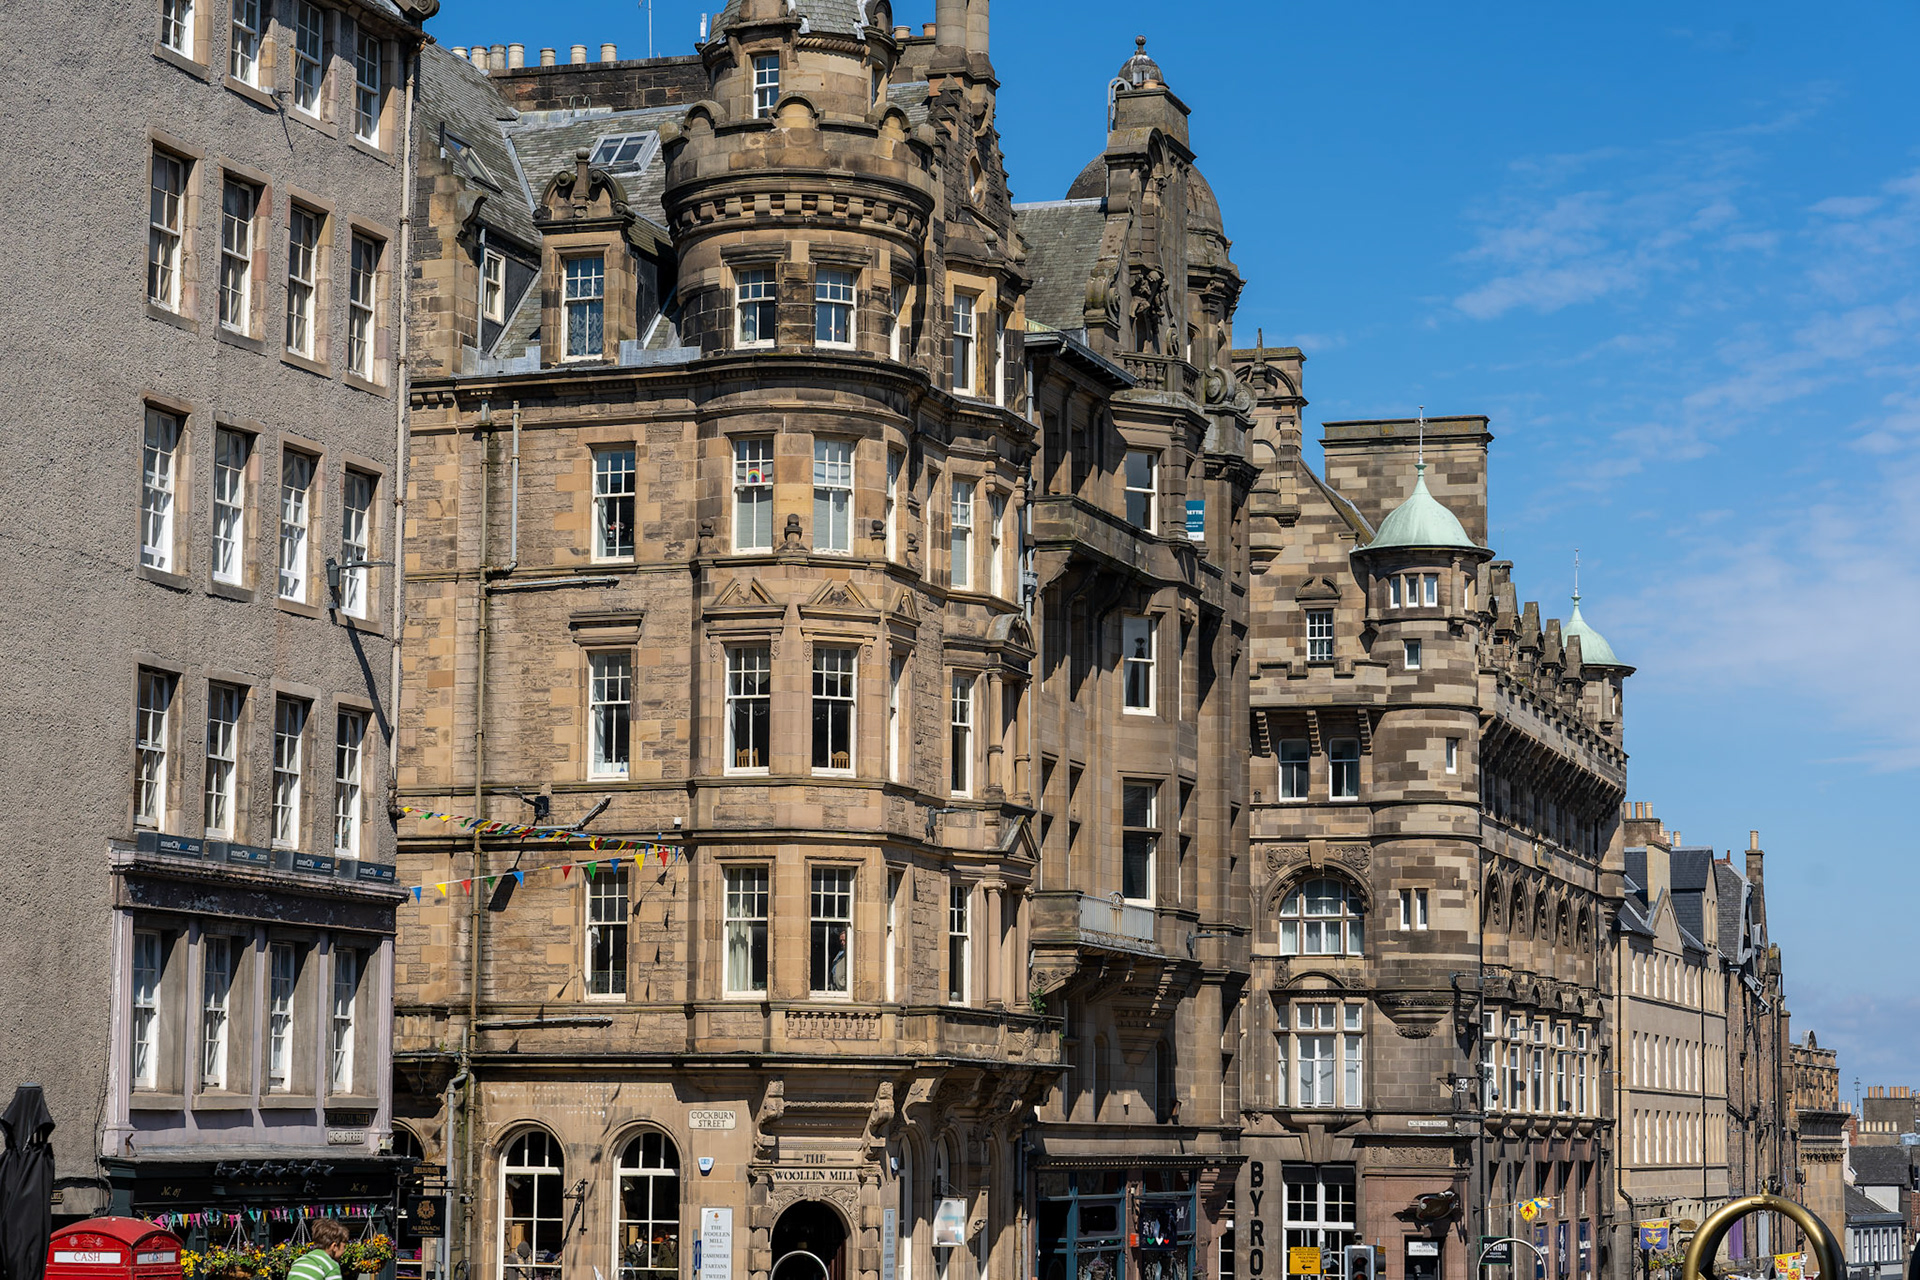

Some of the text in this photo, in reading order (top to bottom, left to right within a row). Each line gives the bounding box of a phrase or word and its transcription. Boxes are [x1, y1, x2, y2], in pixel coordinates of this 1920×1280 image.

[691, 1112, 734, 1120] COCKBURN
[804, 1154, 826, 1164] THE
[774, 1170, 855, 1180] WOOLLEN MILL
[1246, 1161, 1259, 1280] BYRO
[1484, 1242, 1508, 1252] BRON
[74, 1252, 101, 1262] CASH
[148, 1252, 164, 1262] CSH
